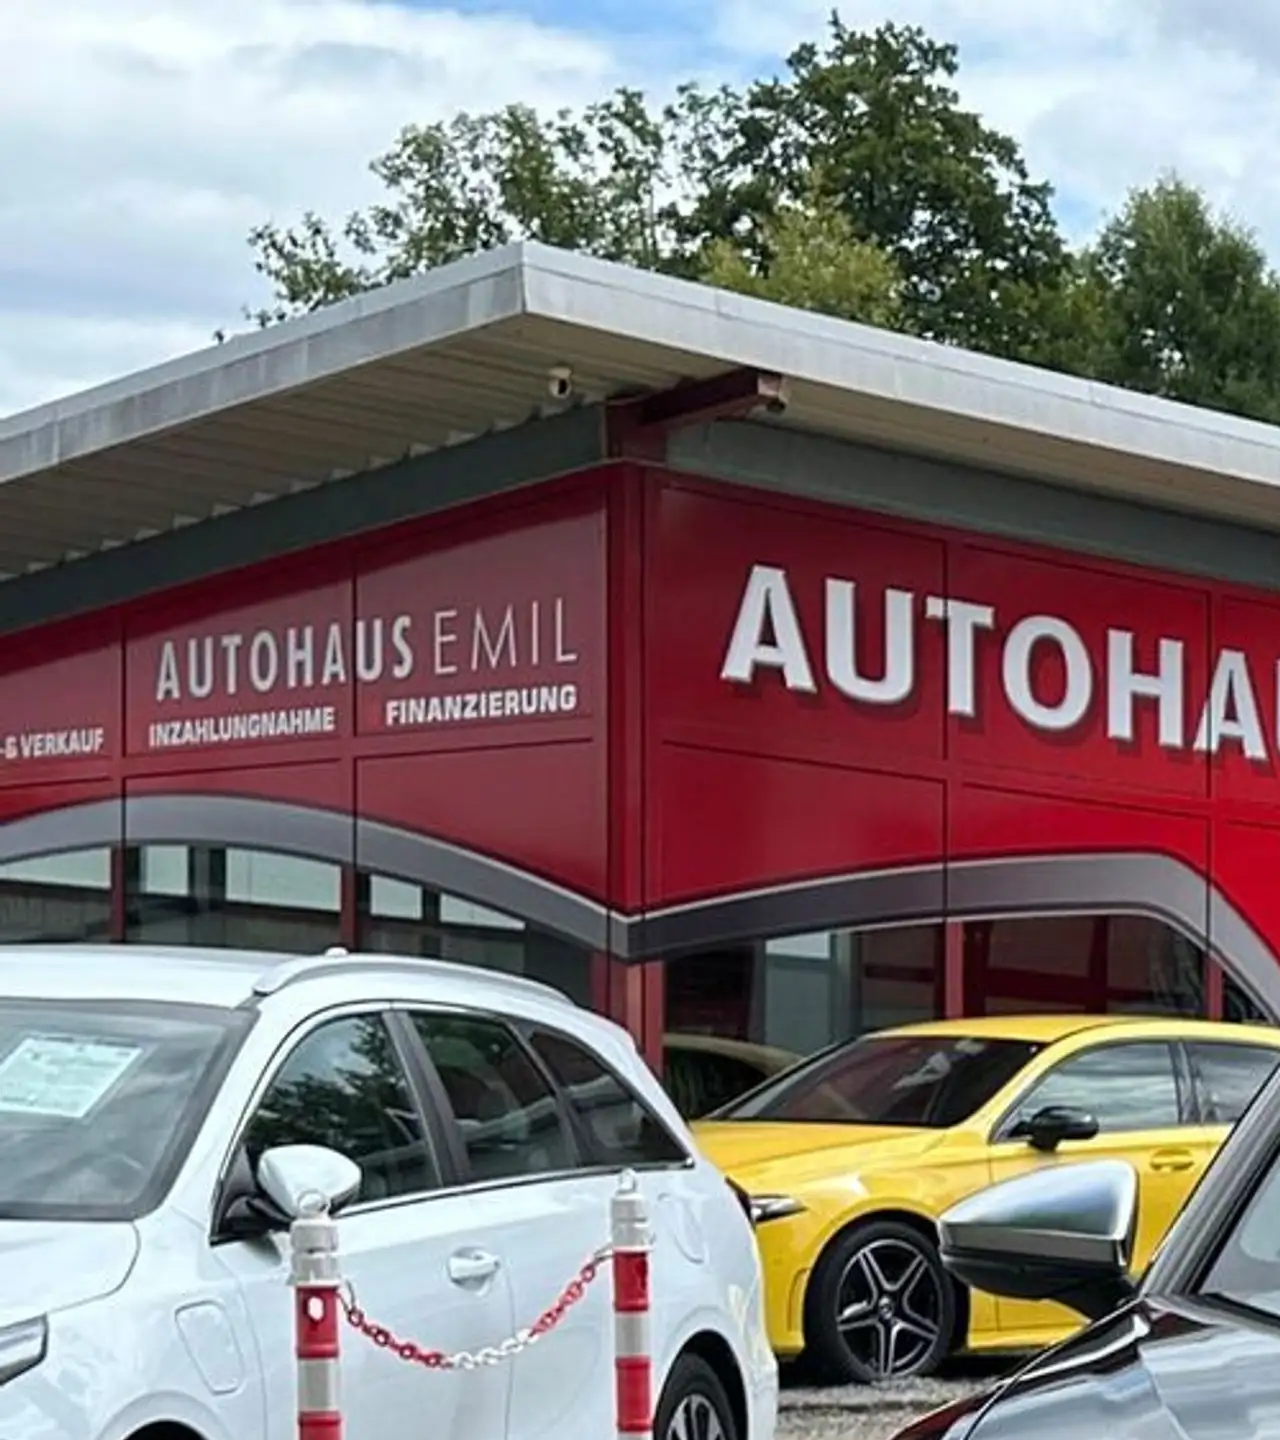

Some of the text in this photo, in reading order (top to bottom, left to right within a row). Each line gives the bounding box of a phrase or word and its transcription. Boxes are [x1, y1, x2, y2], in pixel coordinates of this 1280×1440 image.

[155, 597, 578, 702] AUTOHAUS EMIL
[385, 684, 577, 726] FINANZIERUNG
[20, 727, 104, 758] VERKAUF
[149, 706, 335, 748] INZAHLUNGNAHME
